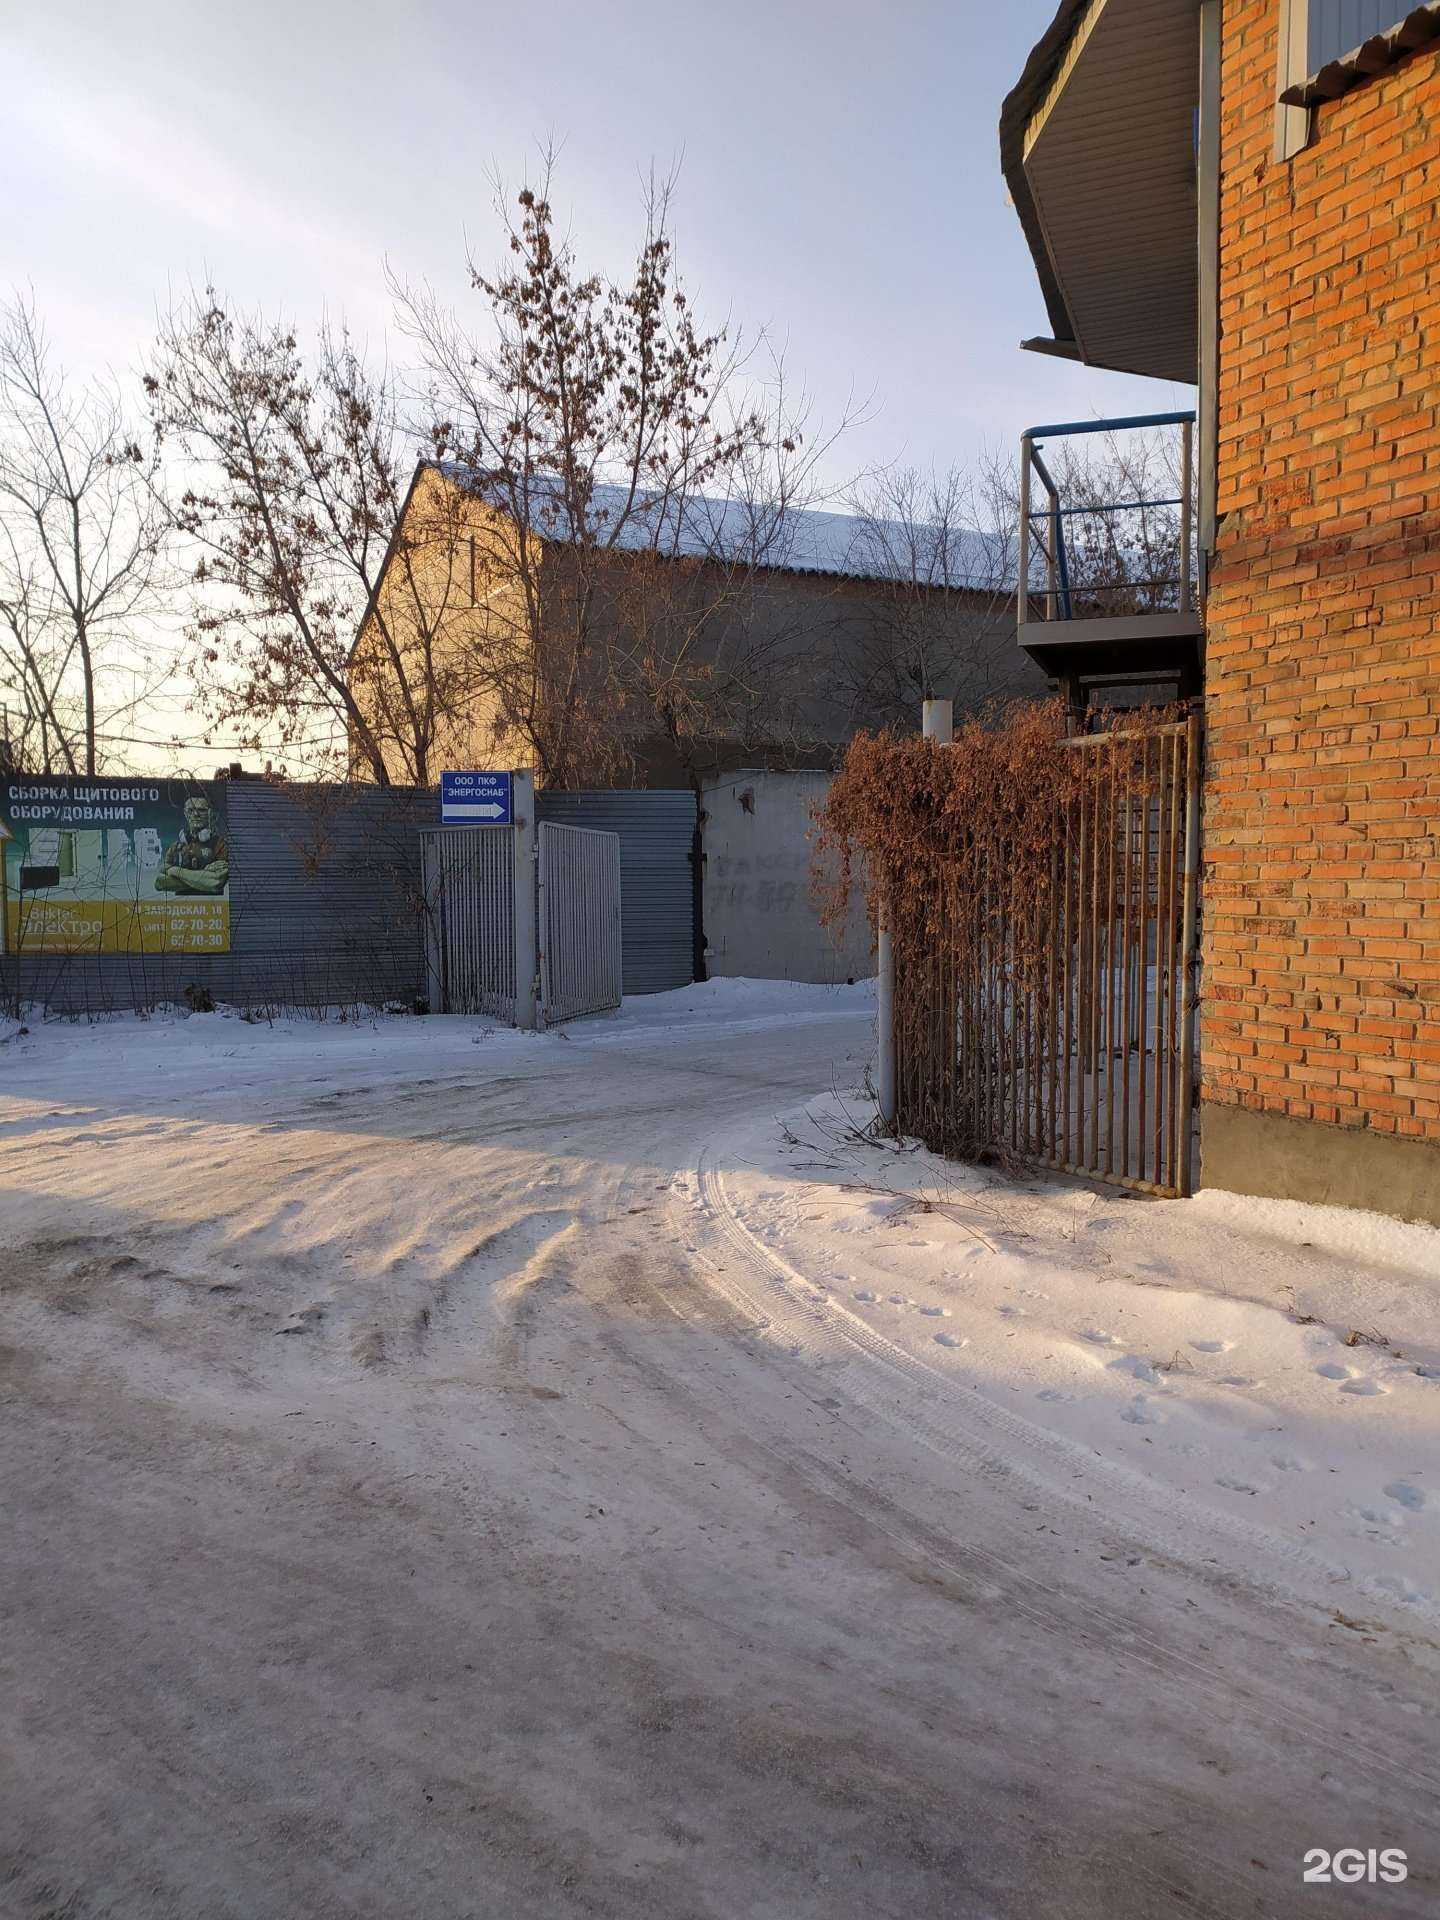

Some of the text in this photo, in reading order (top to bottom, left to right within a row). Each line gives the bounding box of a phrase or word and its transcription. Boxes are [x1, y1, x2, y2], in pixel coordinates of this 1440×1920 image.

[455, 776, 497, 785] ООО ПКФ
[9, 785, 160, 803] СБОРКА ЩИТОВОГО
[444, 787, 508, 797] "ЭНЕРГОСНАБ"
[10, 805, 135, 822] ОБОРУДОВАНИЯ
